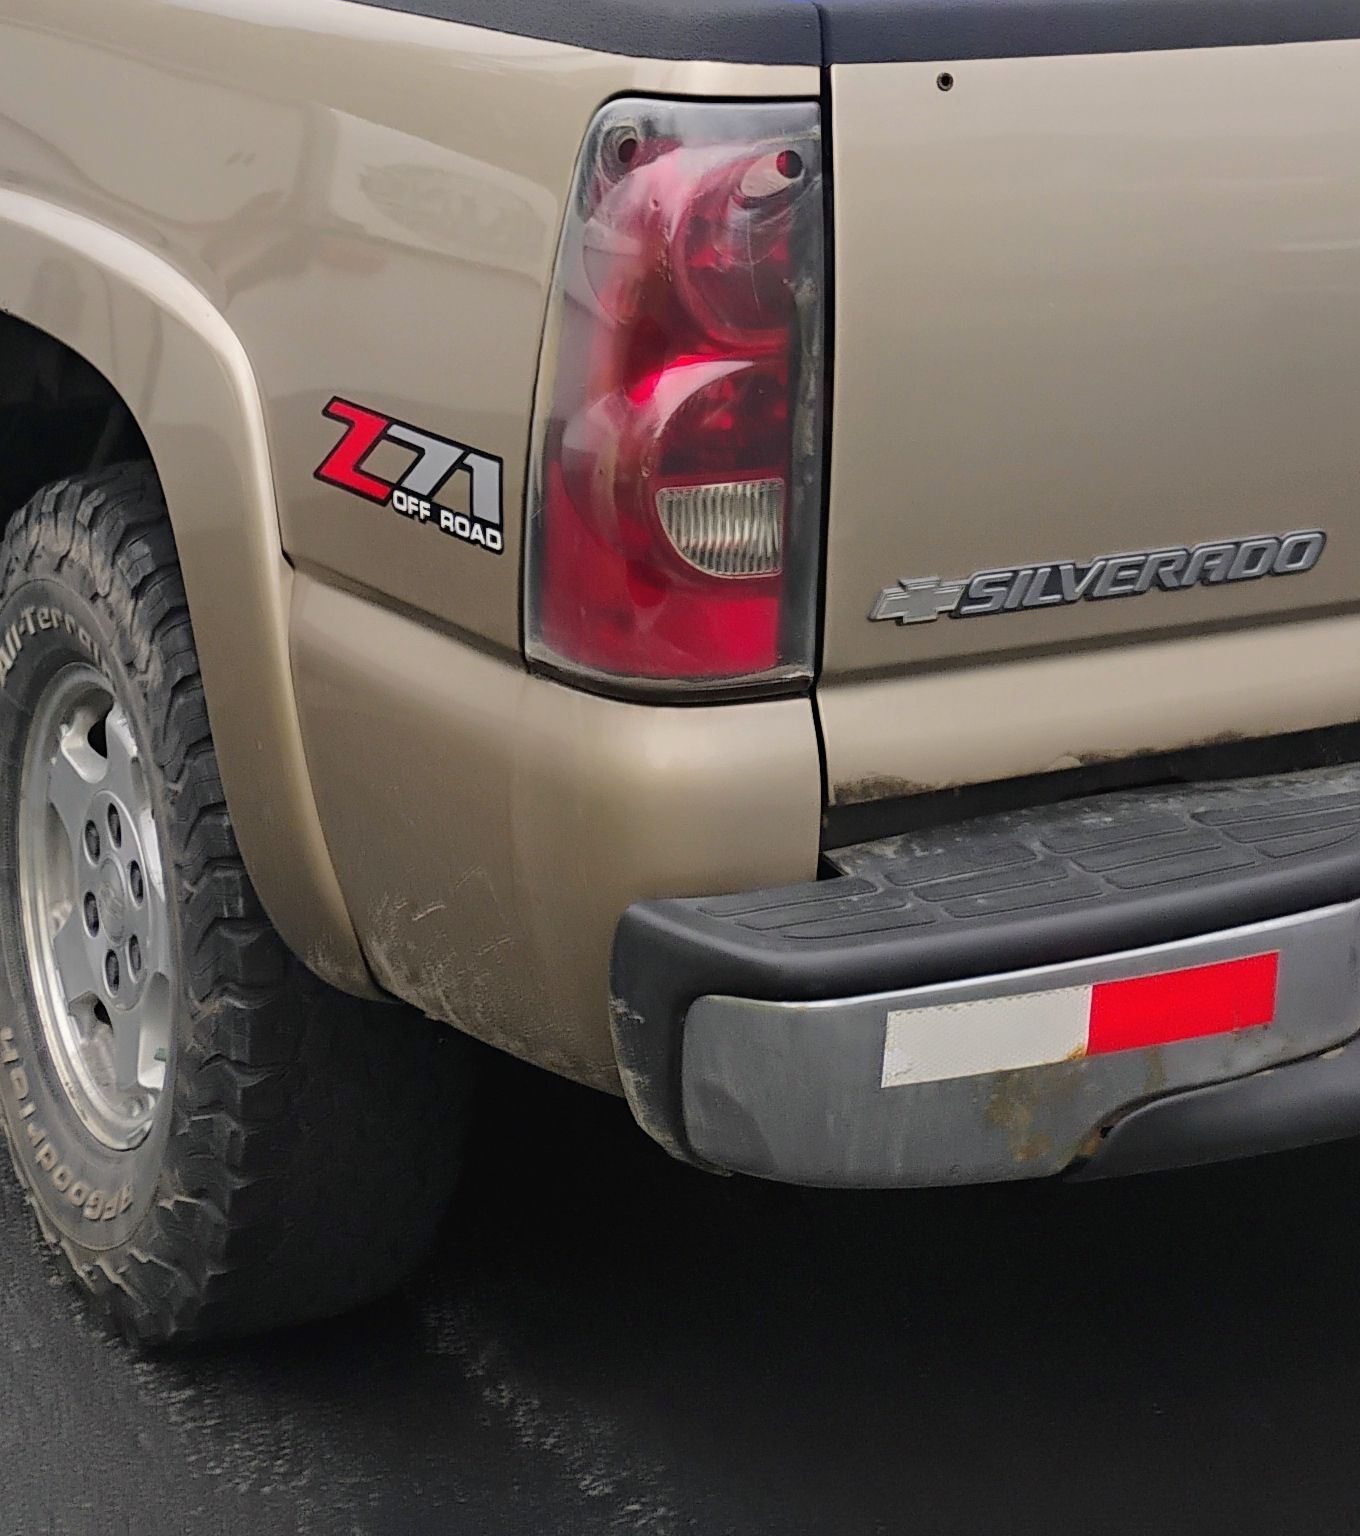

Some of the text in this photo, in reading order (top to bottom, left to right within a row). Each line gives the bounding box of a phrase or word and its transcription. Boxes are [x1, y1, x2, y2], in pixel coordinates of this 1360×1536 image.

[313, 395, 504, 524] Z71
[392, 489, 503, 551] OFF ROAD
[952, 530, 1327, 619] SILVERADO
